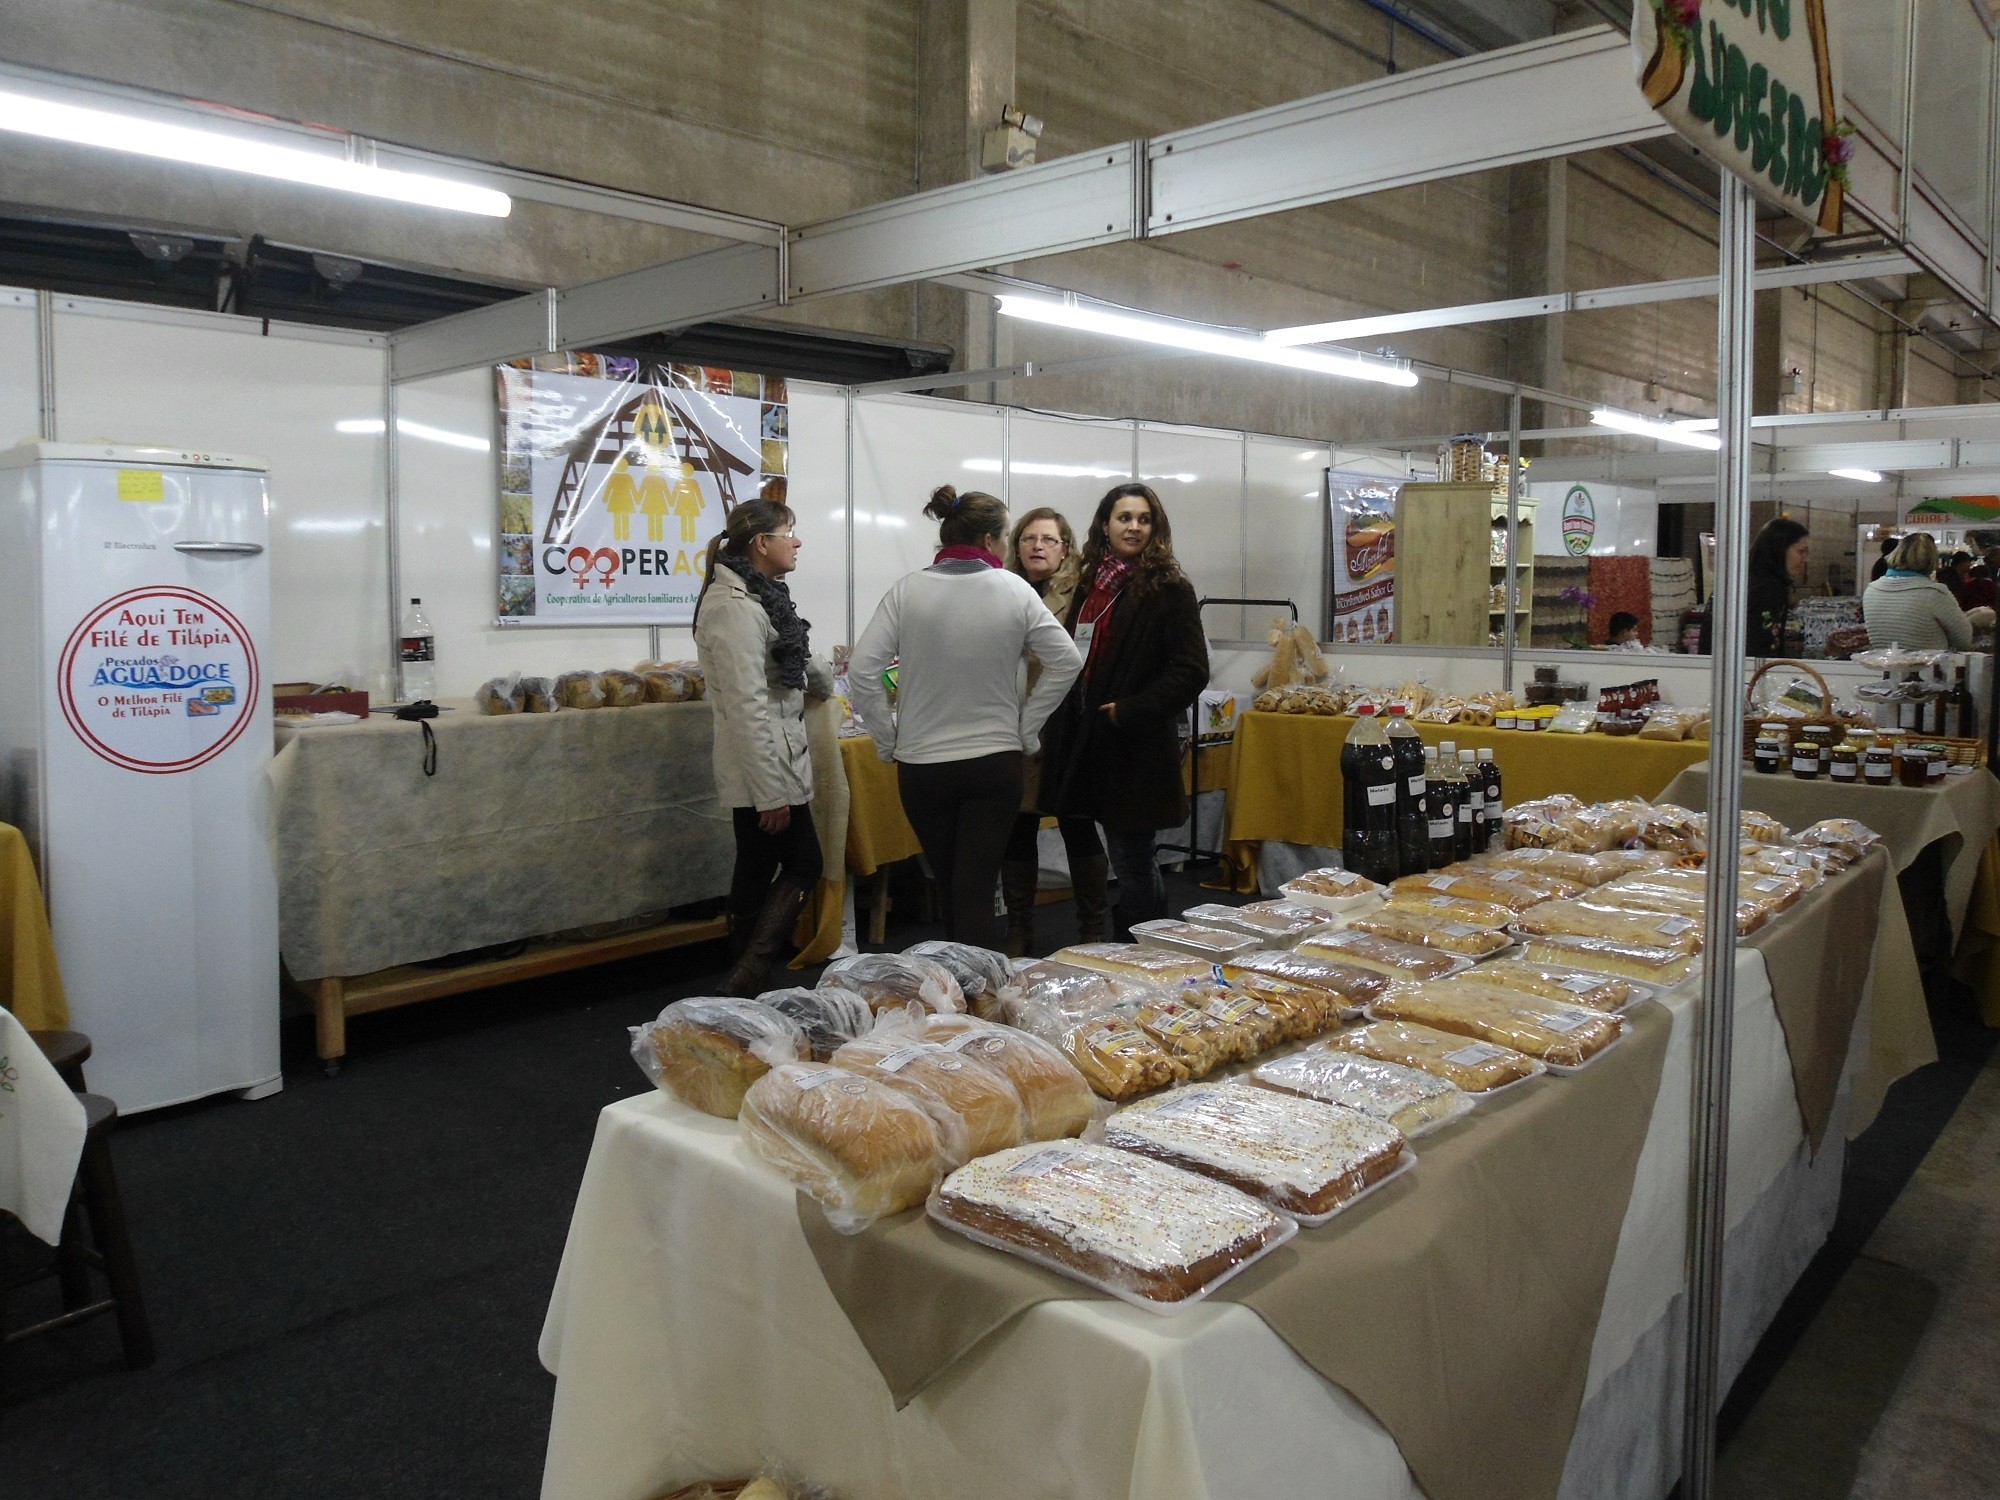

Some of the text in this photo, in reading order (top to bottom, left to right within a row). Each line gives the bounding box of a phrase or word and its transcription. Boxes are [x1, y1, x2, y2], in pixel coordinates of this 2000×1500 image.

[546, 593, 591, 606] Cooperativa
[592, 593, 602, 604] de
[648, 593, 683, 604] Familiares
[118, 608, 165, 627] Aqui
[91, 628, 231, 648] Filé de Tilápia
[105, 656, 159, 667] Pescados
[93, 661, 230, 686] ÁGUA DOCE
[98, 692, 183, 706] O Melhor Filé
[112, 706, 171, 718] de Tilápia
